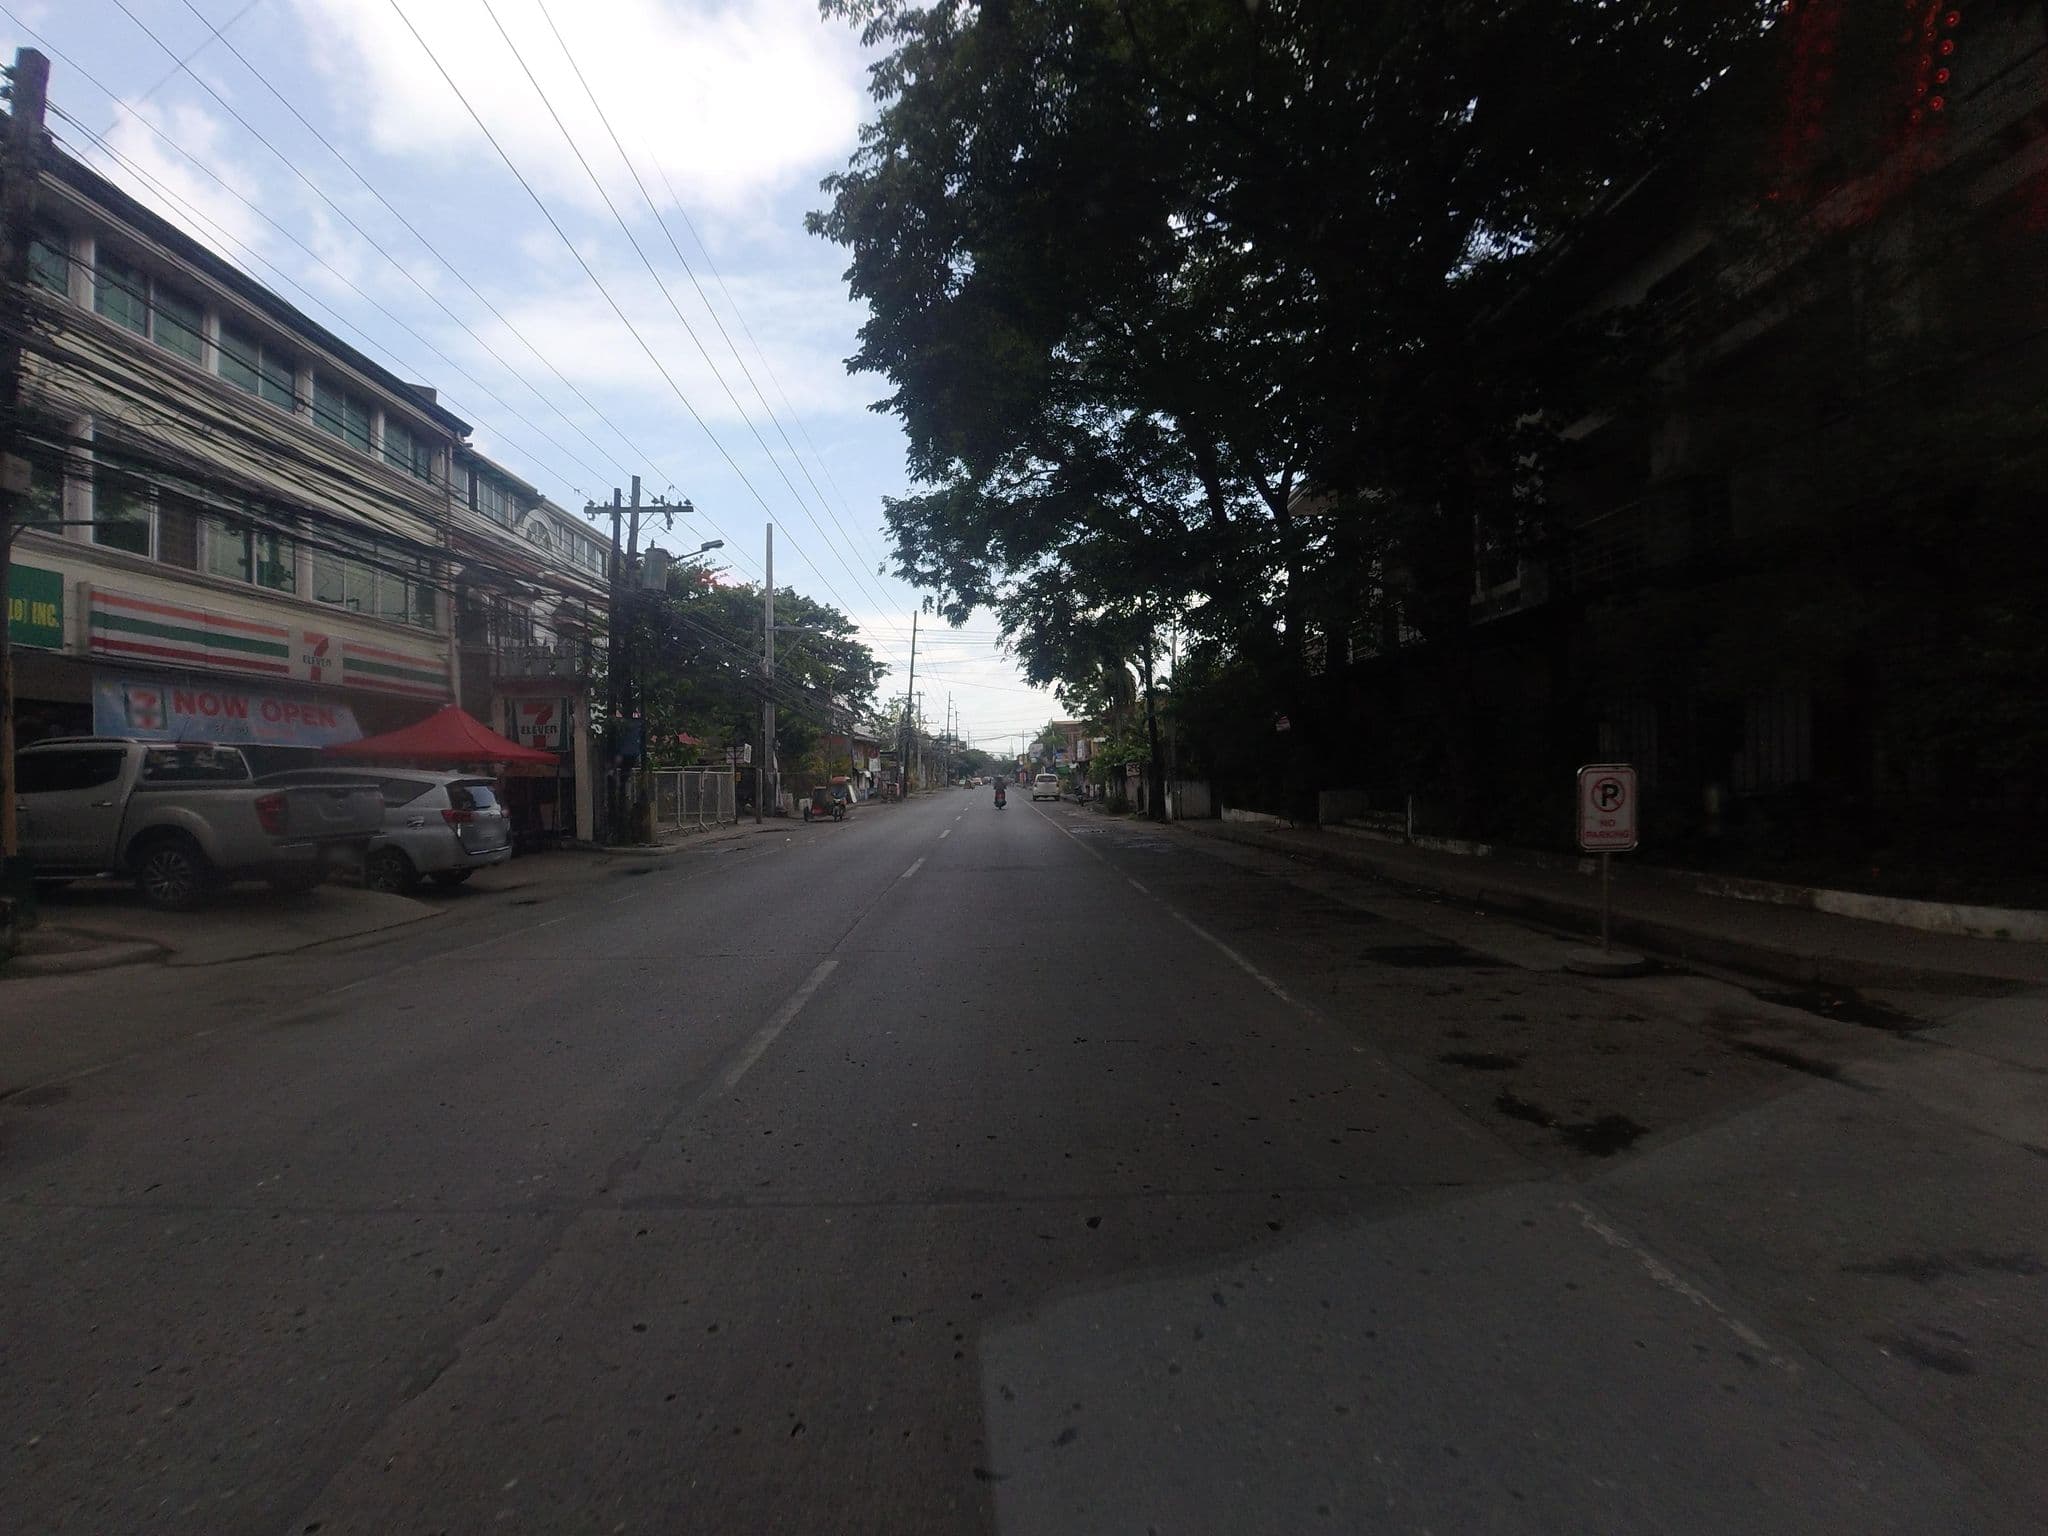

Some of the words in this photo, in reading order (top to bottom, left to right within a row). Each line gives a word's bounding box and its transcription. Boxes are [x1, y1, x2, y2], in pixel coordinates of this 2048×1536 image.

[303, 631, 329, 681] 7
[173, 688, 248, 719] NOW
[261, 699, 336, 728] OPEN
[523, 703, 554, 748] 7
[1600, 819, 1616, 827] NO
